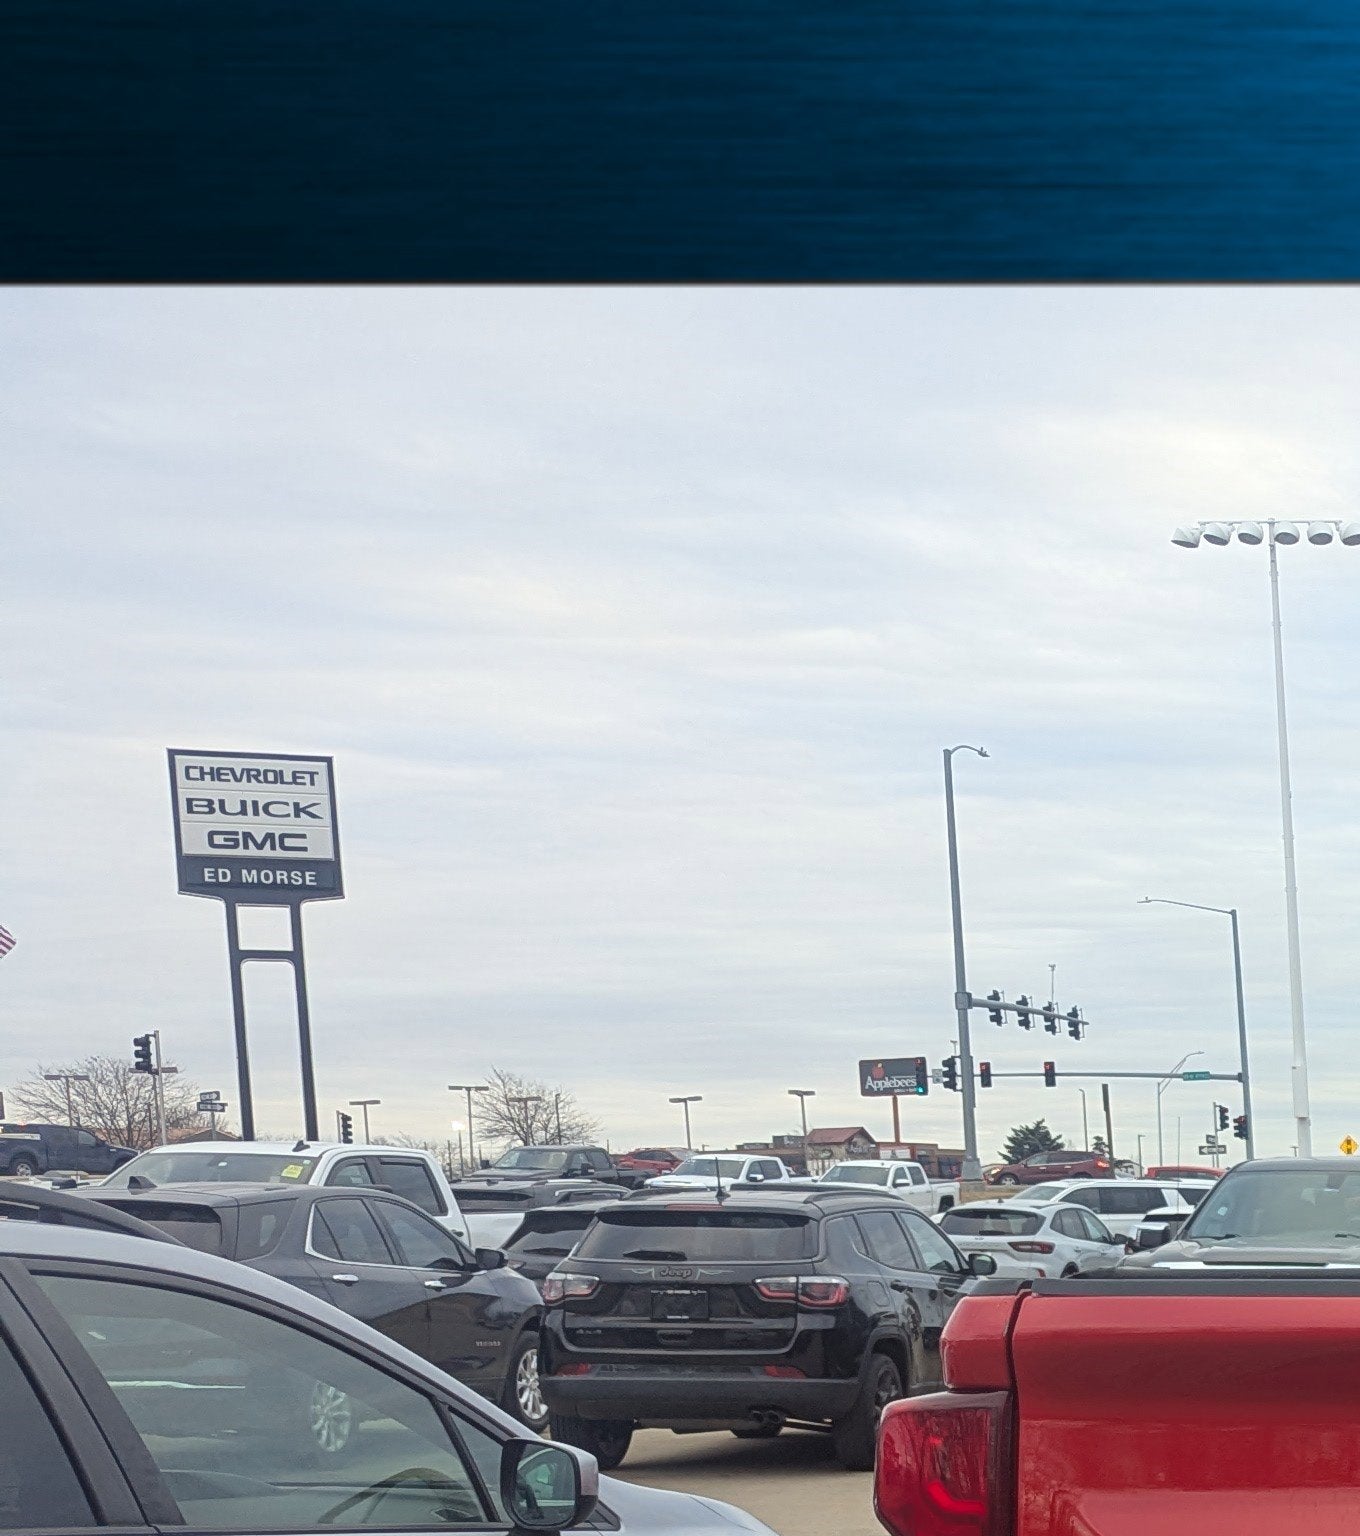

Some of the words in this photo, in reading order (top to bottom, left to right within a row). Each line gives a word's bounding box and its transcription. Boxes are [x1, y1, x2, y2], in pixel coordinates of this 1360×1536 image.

[184, 765, 320, 787] CHEVROLET
[185, 797, 324, 820] BUICK
[207, 829, 309, 852] GMC
[203, 867, 232, 884] ED
[241, 868, 318, 886] MORSE
[659, 1266, 693, 1280] Jeep
